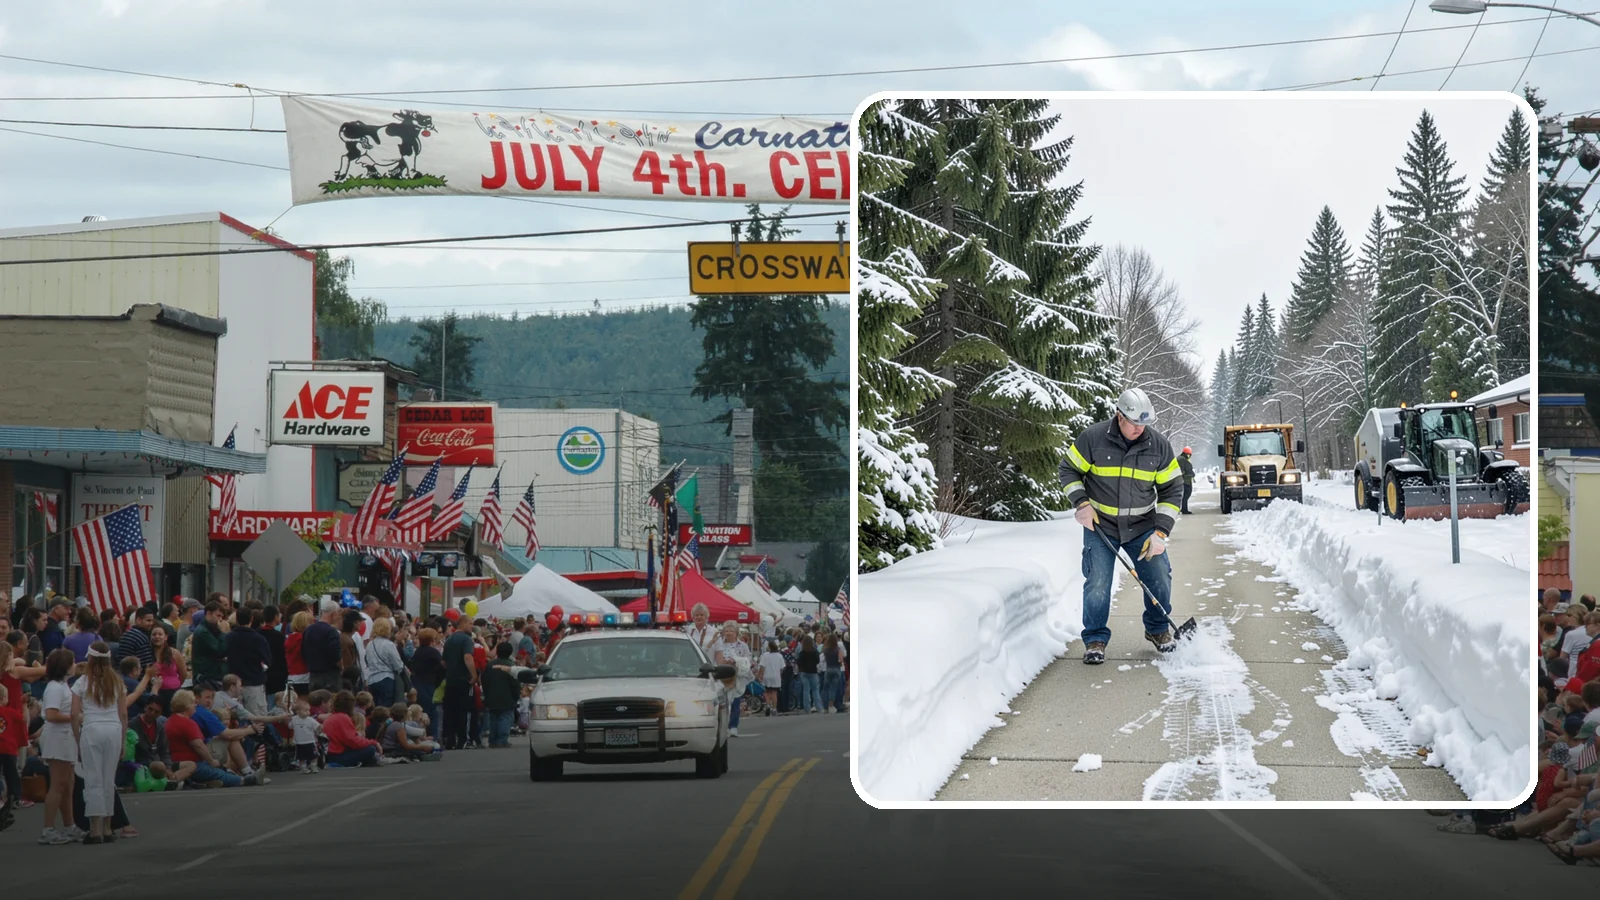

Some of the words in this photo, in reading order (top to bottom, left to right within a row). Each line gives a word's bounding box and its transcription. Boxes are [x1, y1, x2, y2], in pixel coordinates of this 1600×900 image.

[695, 121, 850, 150] Carnat
[481, 141, 605, 192] JULY
[632, 149, 746, 198] 4th.
[696, 254, 850, 280] CROSSWA
[282, 380, 373, 420] ACE
[406, 409, 453, 422] CEDAR
[283, 421, 371, 436] Hardware
[95, 485, 124, 495] Vincent
[126, 486, 136, 495] de
[138, 486, 155, 495] Paul
[688, 526, 742, 535] CRNATION
